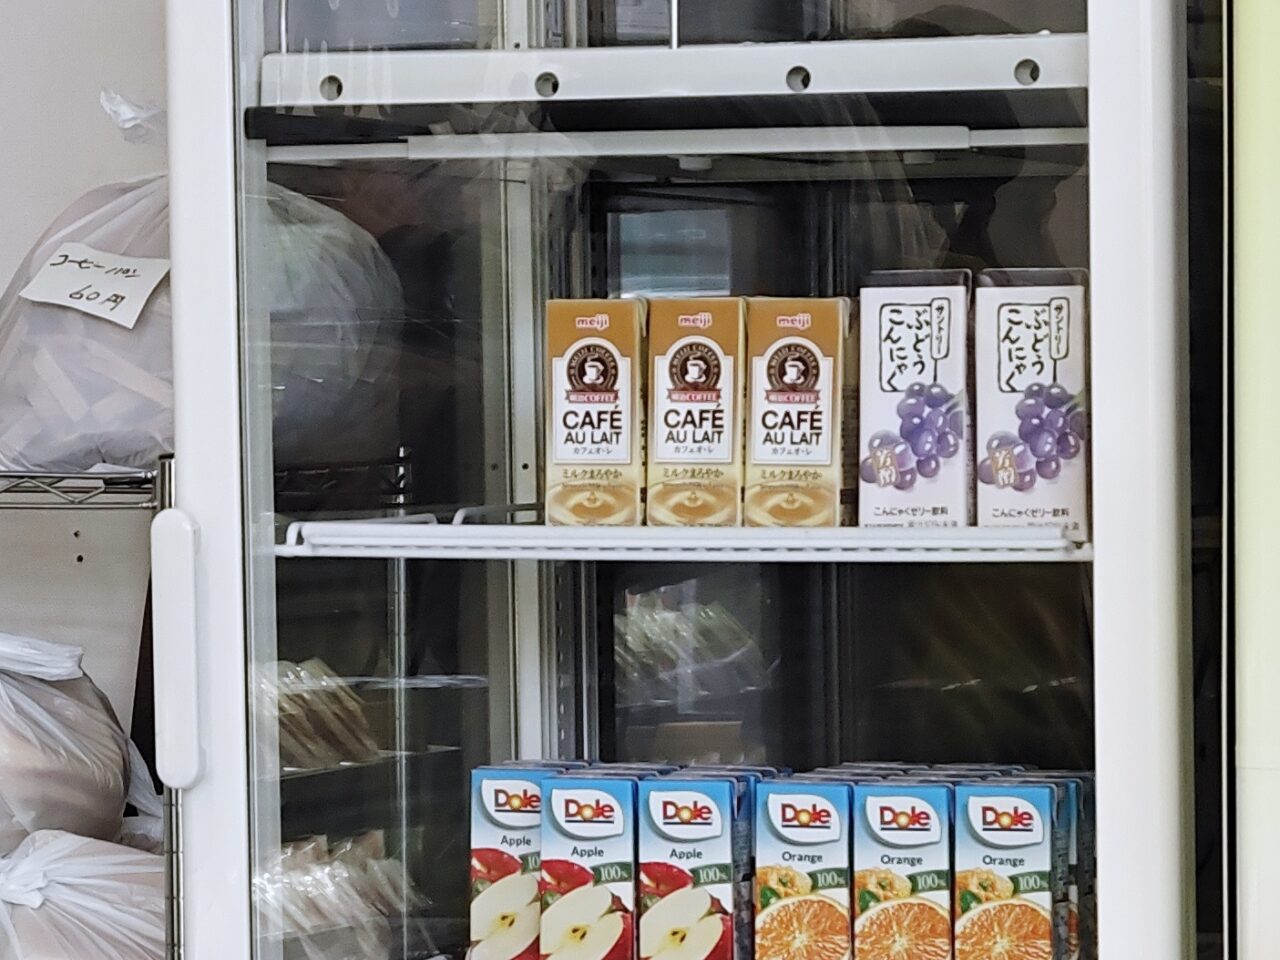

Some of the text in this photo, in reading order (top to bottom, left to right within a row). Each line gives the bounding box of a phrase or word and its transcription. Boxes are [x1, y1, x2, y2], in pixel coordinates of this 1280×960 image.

[576, 314, 609, 330] meiji
[678, 312, 712, 329] meiji
[777, 313, 811, 330] meiji
[935, 303, 946, 355] サントリー
[1054, 303, 1065, 355] サントリー
[883, 308, 908, 391] こんにゃく
[906, 309, 932, 375] ぶどう
[1002, 308, 1027, 392] こんにゃく
[1025, 309, 1050, 375] ぶどう
[562, 404, 622, 430] CAFÉ
[663, 403, 724, 429] CAFÉ
[761, 404, 823, 430] CAFÉ
[564, 432, 622, 445] AU LAIT
[665, 431, 724, 444] AU LAIT
[763, 432, 823, 445] AU LAIT
[494, 788, 541, 810] Dole
[564, 799, 615, 821] Dole
[662, 800, 713, 822] Dole
[781, 803, 832, 827] Dole
[879, 805, 930, 829] Dole
[981, 806, 1034, 831] Dole
[500, 835, 532, 848] Apple
[571, 846, 604, 858] Apple
[527, 855, 541, 869] 10
[669, 848, 703, 860] Apple
[781, 852, 823, 866] Orange
[880, 854, 924, 867] Orange
[982, 855, 1025, 868] Orange
